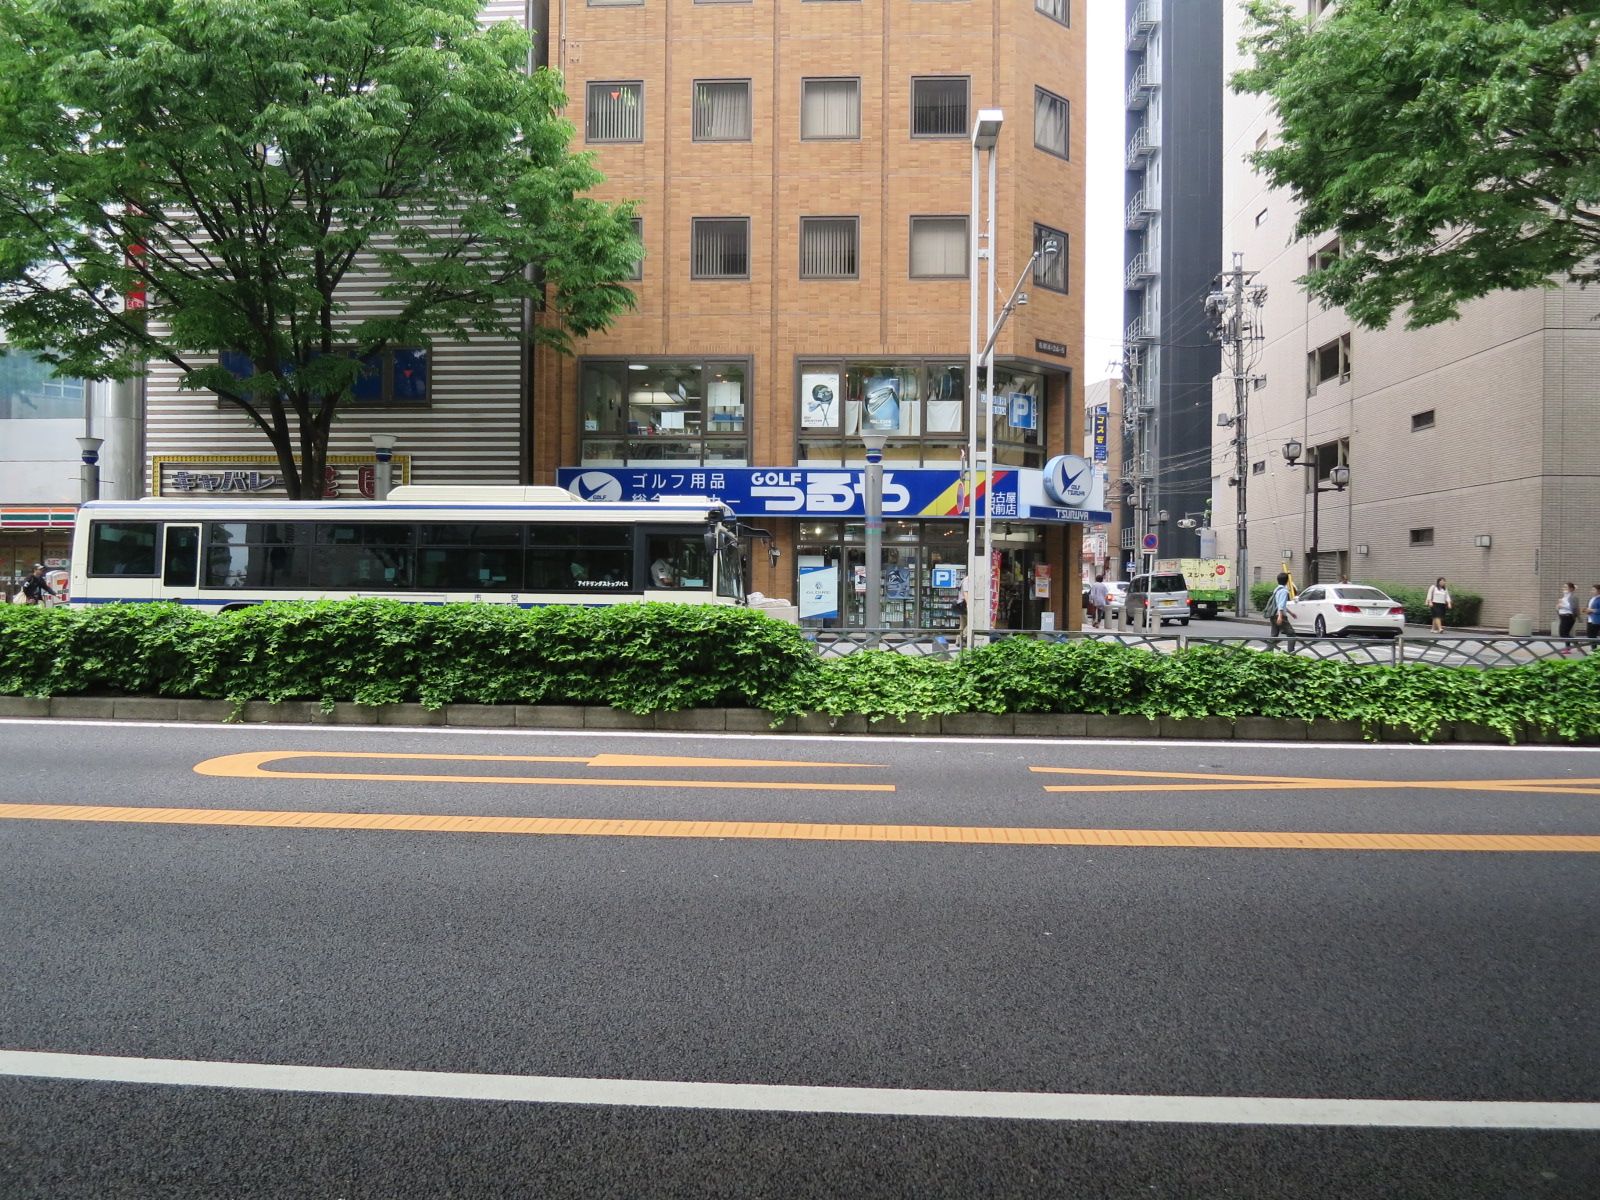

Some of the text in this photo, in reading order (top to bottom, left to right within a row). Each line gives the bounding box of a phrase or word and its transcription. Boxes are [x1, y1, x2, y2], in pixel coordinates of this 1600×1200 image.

[1013, 397, 1029, 423] P
[632, 473, 725, 490] ゴルフ用品
[751, 472, 802, 486] GOLF
[1056, 509, 1089, 521] TSURUYA
[936, 571, 949, 586] P
